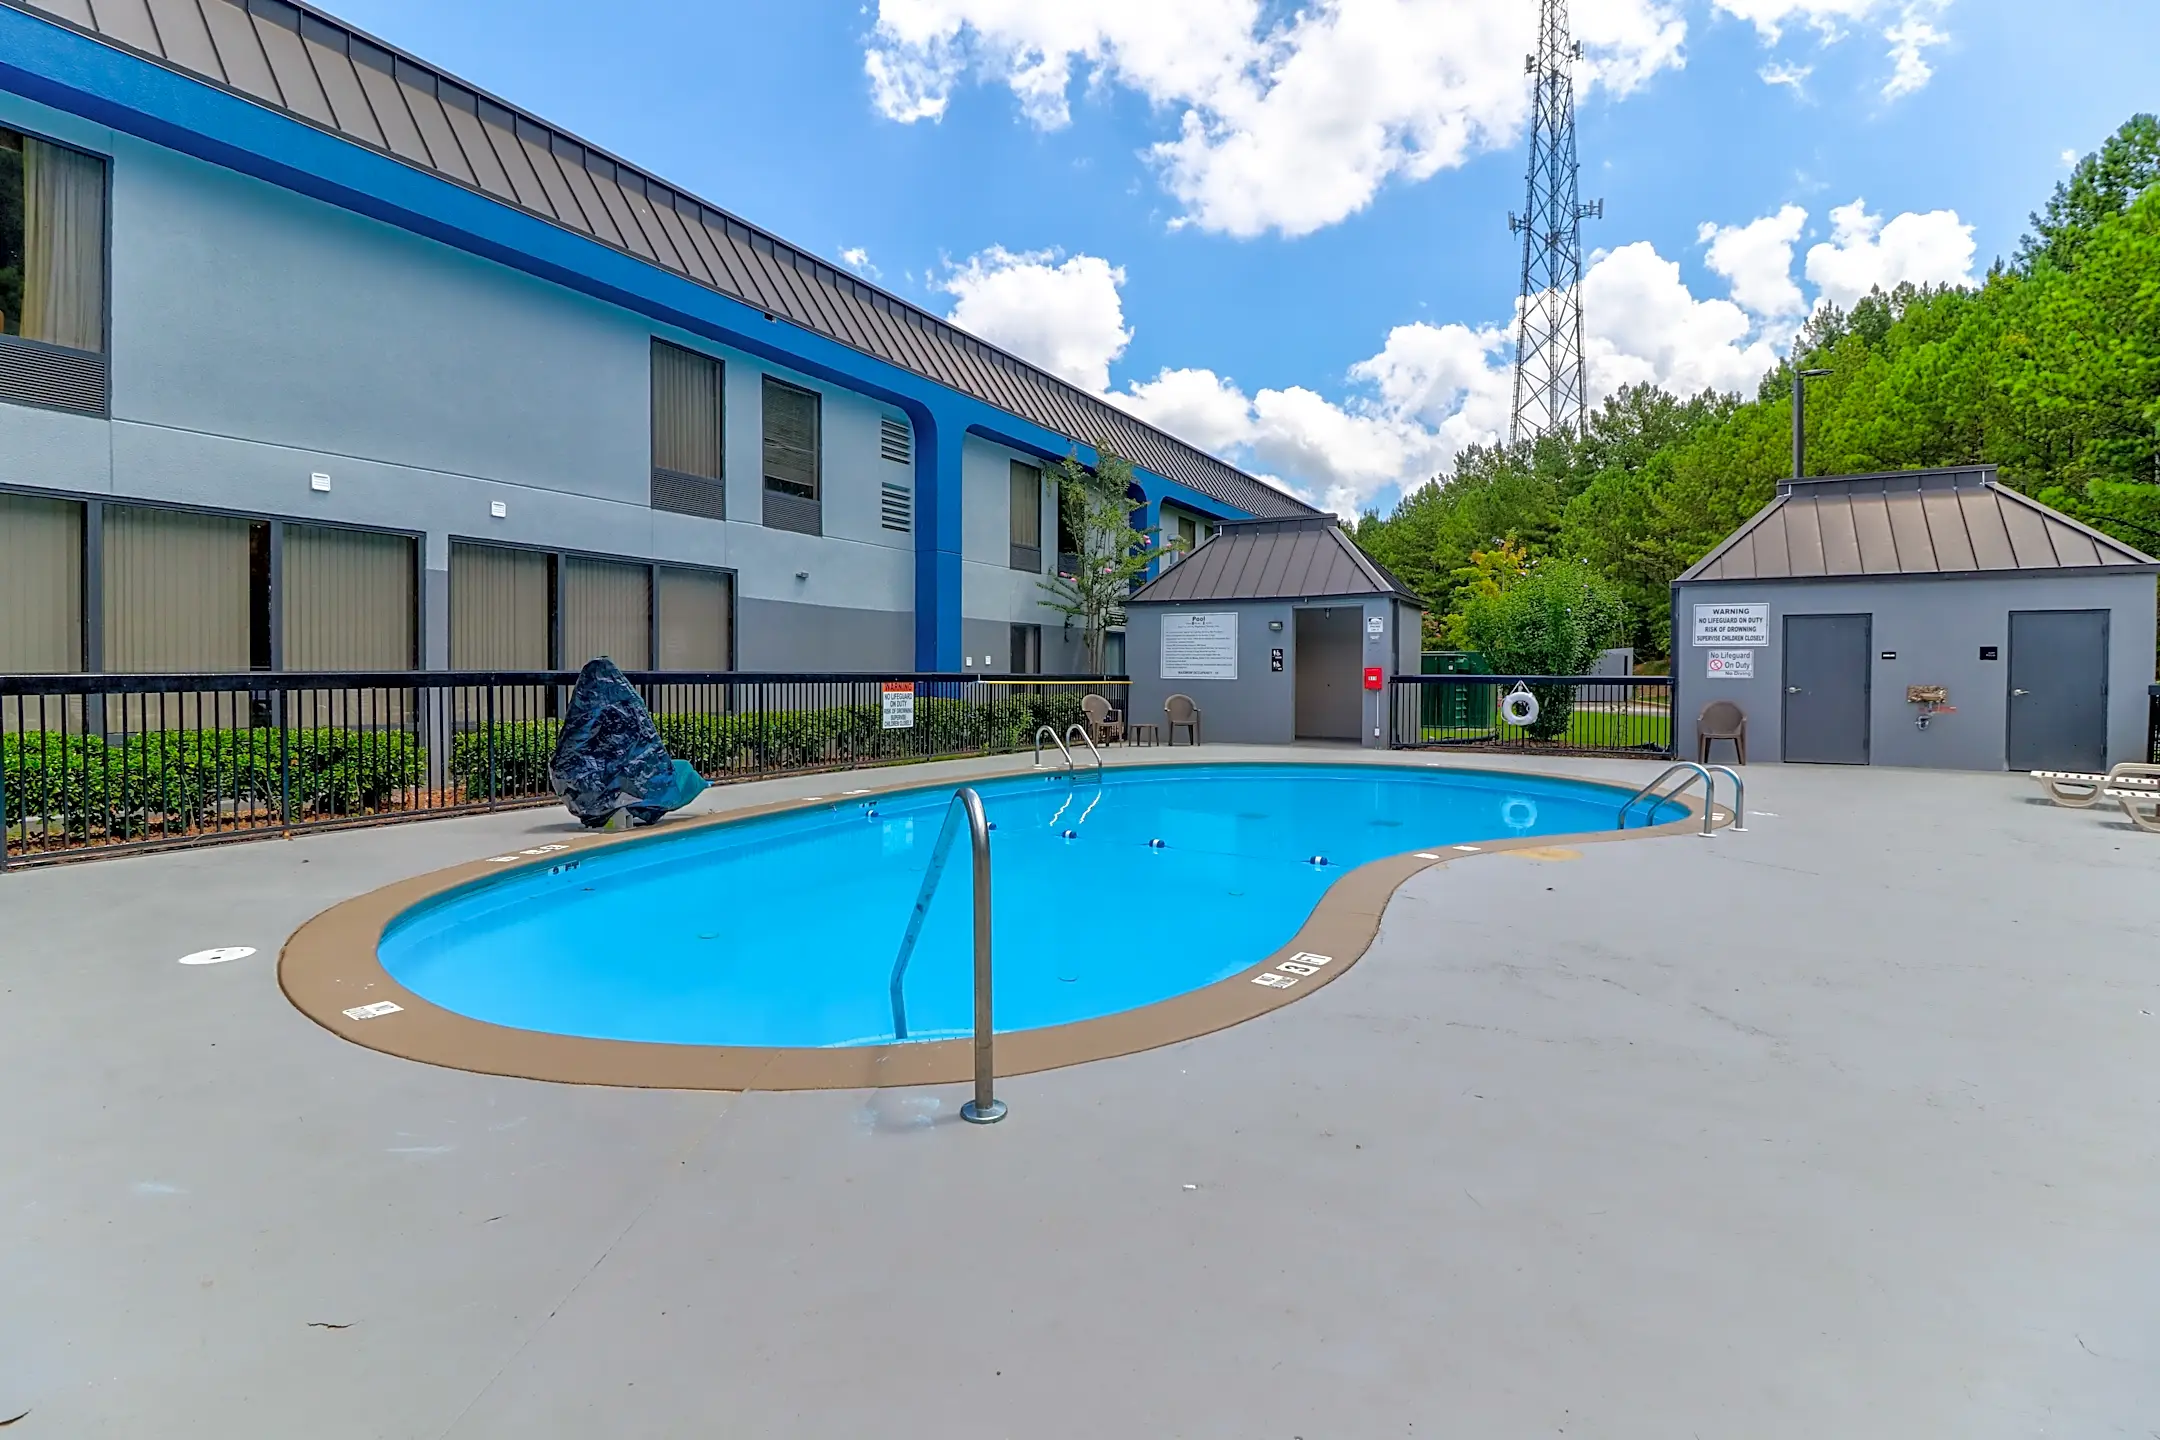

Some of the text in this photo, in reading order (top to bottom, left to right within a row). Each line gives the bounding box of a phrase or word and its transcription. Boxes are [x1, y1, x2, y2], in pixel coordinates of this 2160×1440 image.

[1720, 652, 1751, 660] Lifeguard
[1724, 661, 1751, 670] On Duty
[885, 683, 913, 691] WARNING
